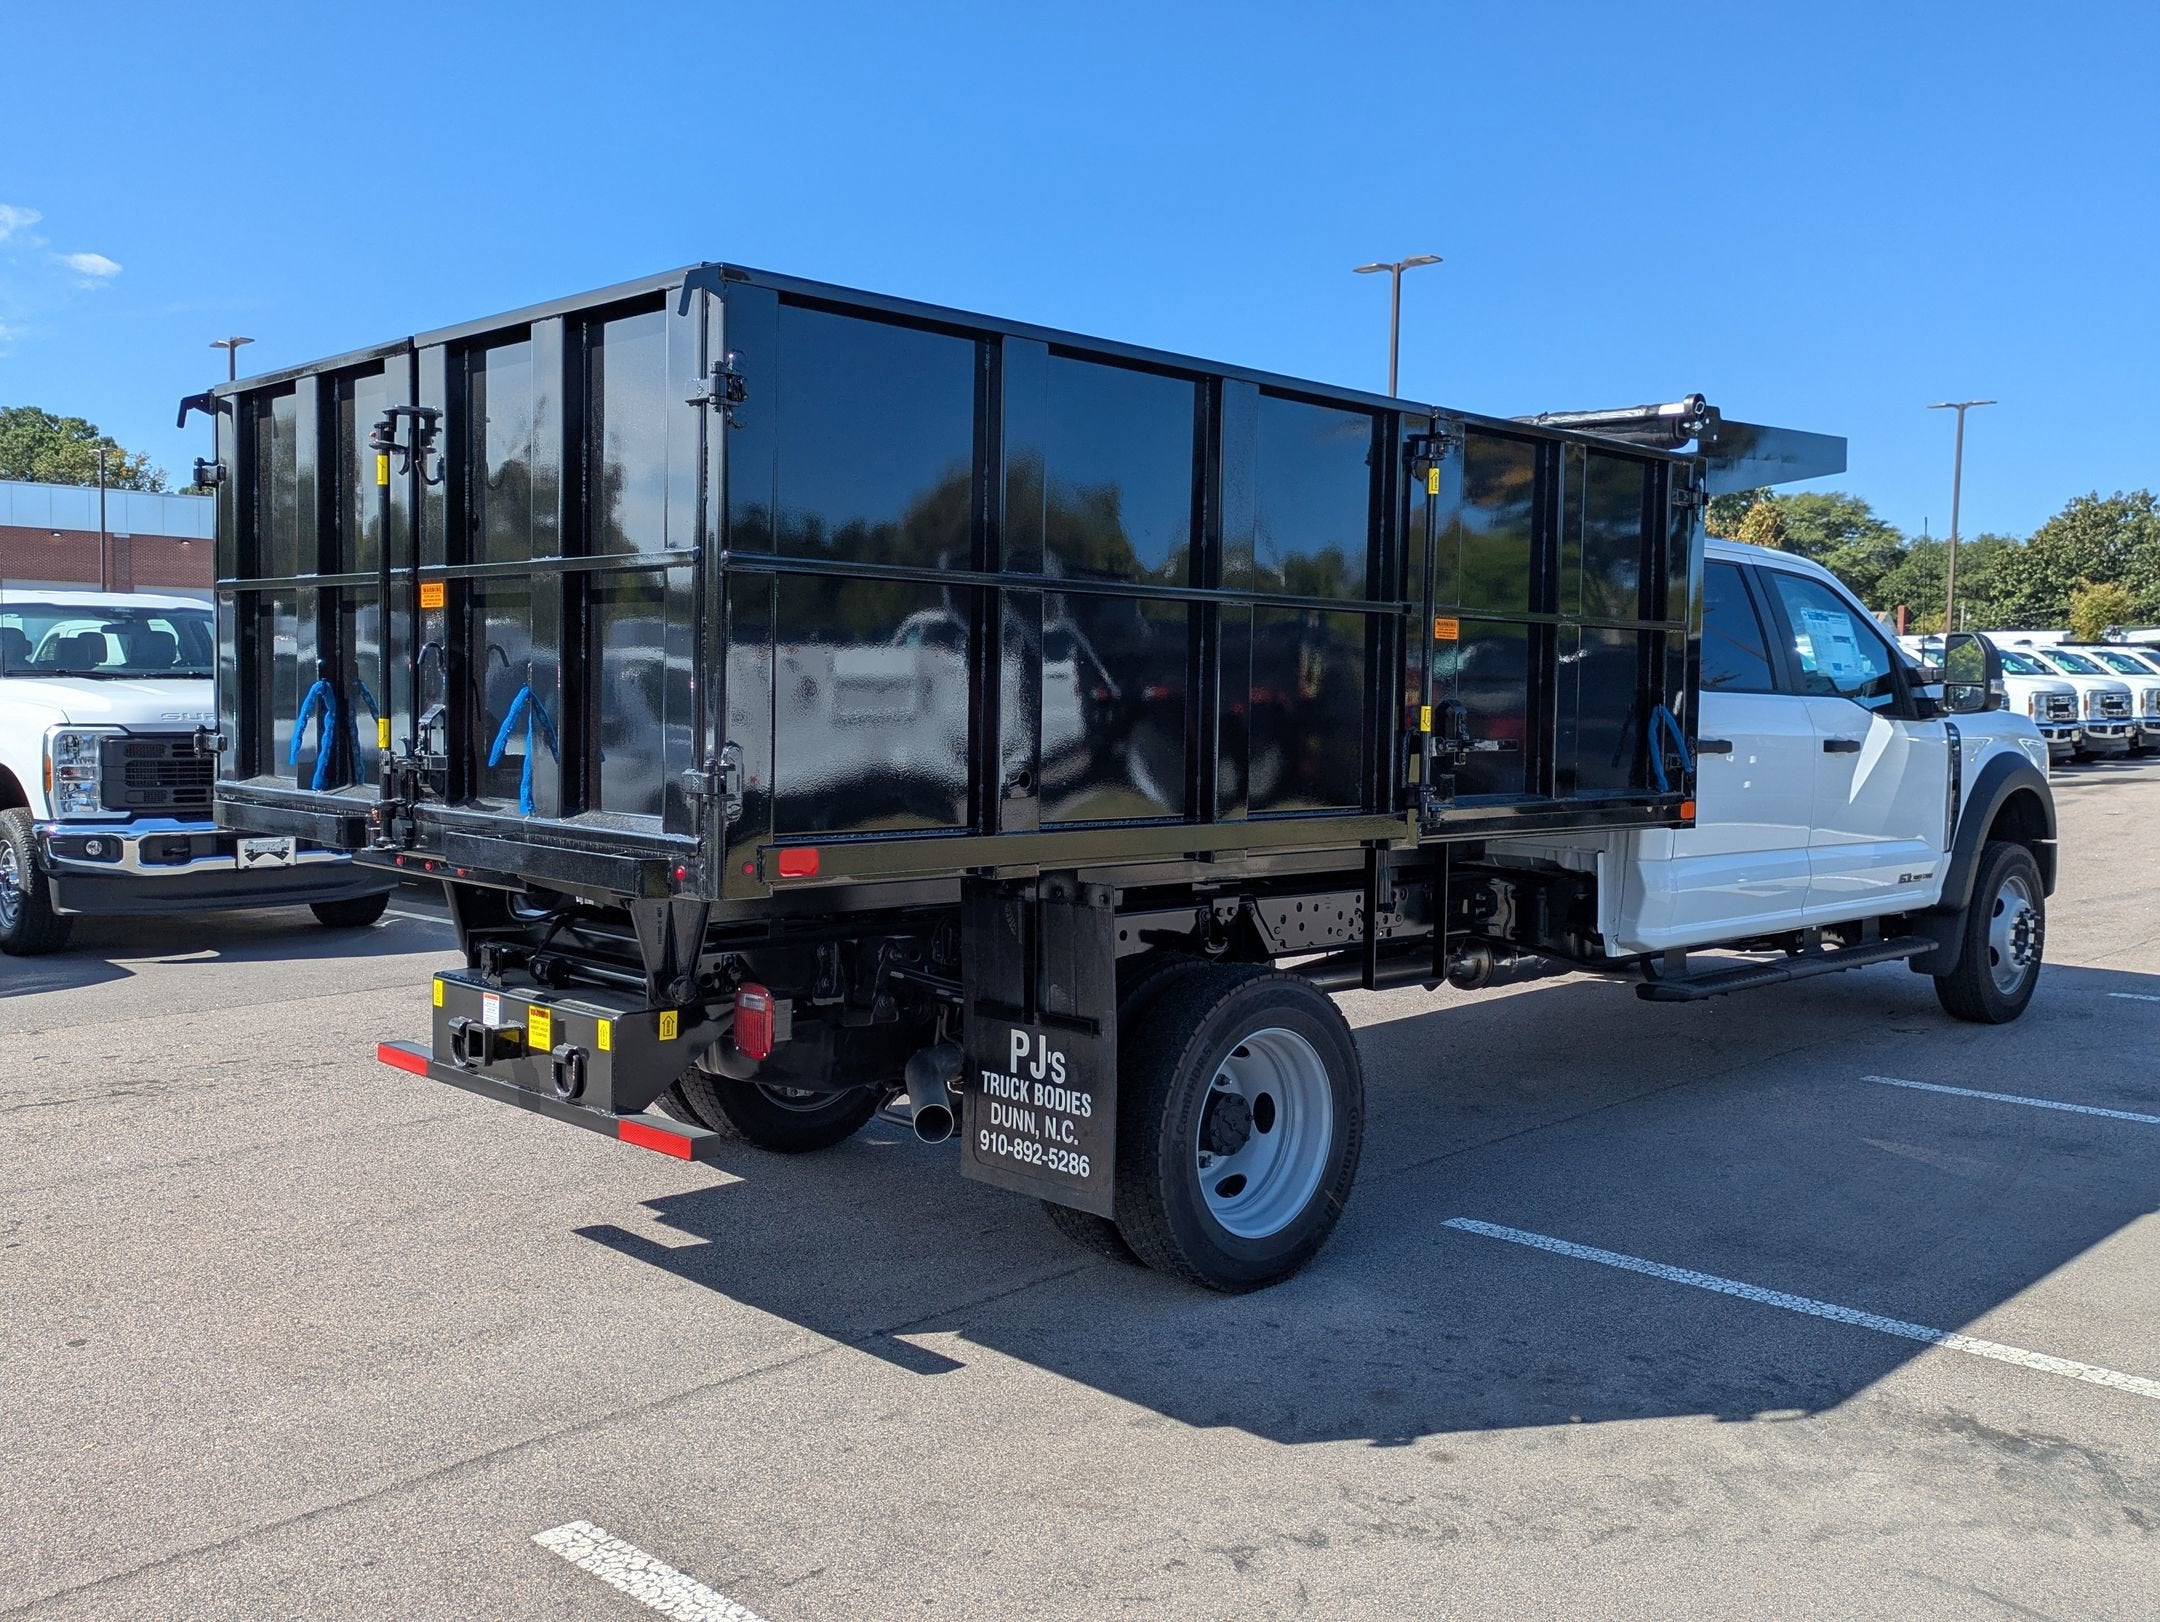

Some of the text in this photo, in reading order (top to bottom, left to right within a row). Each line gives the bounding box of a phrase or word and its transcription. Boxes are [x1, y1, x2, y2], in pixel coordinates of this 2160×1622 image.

[981, 1070, 1092, 1118] TRUCK BODIES
[990, 1102, 1079, 1146] DUNN, N.C.
[979, 1129, 1090, 1178] 910-892-5286
